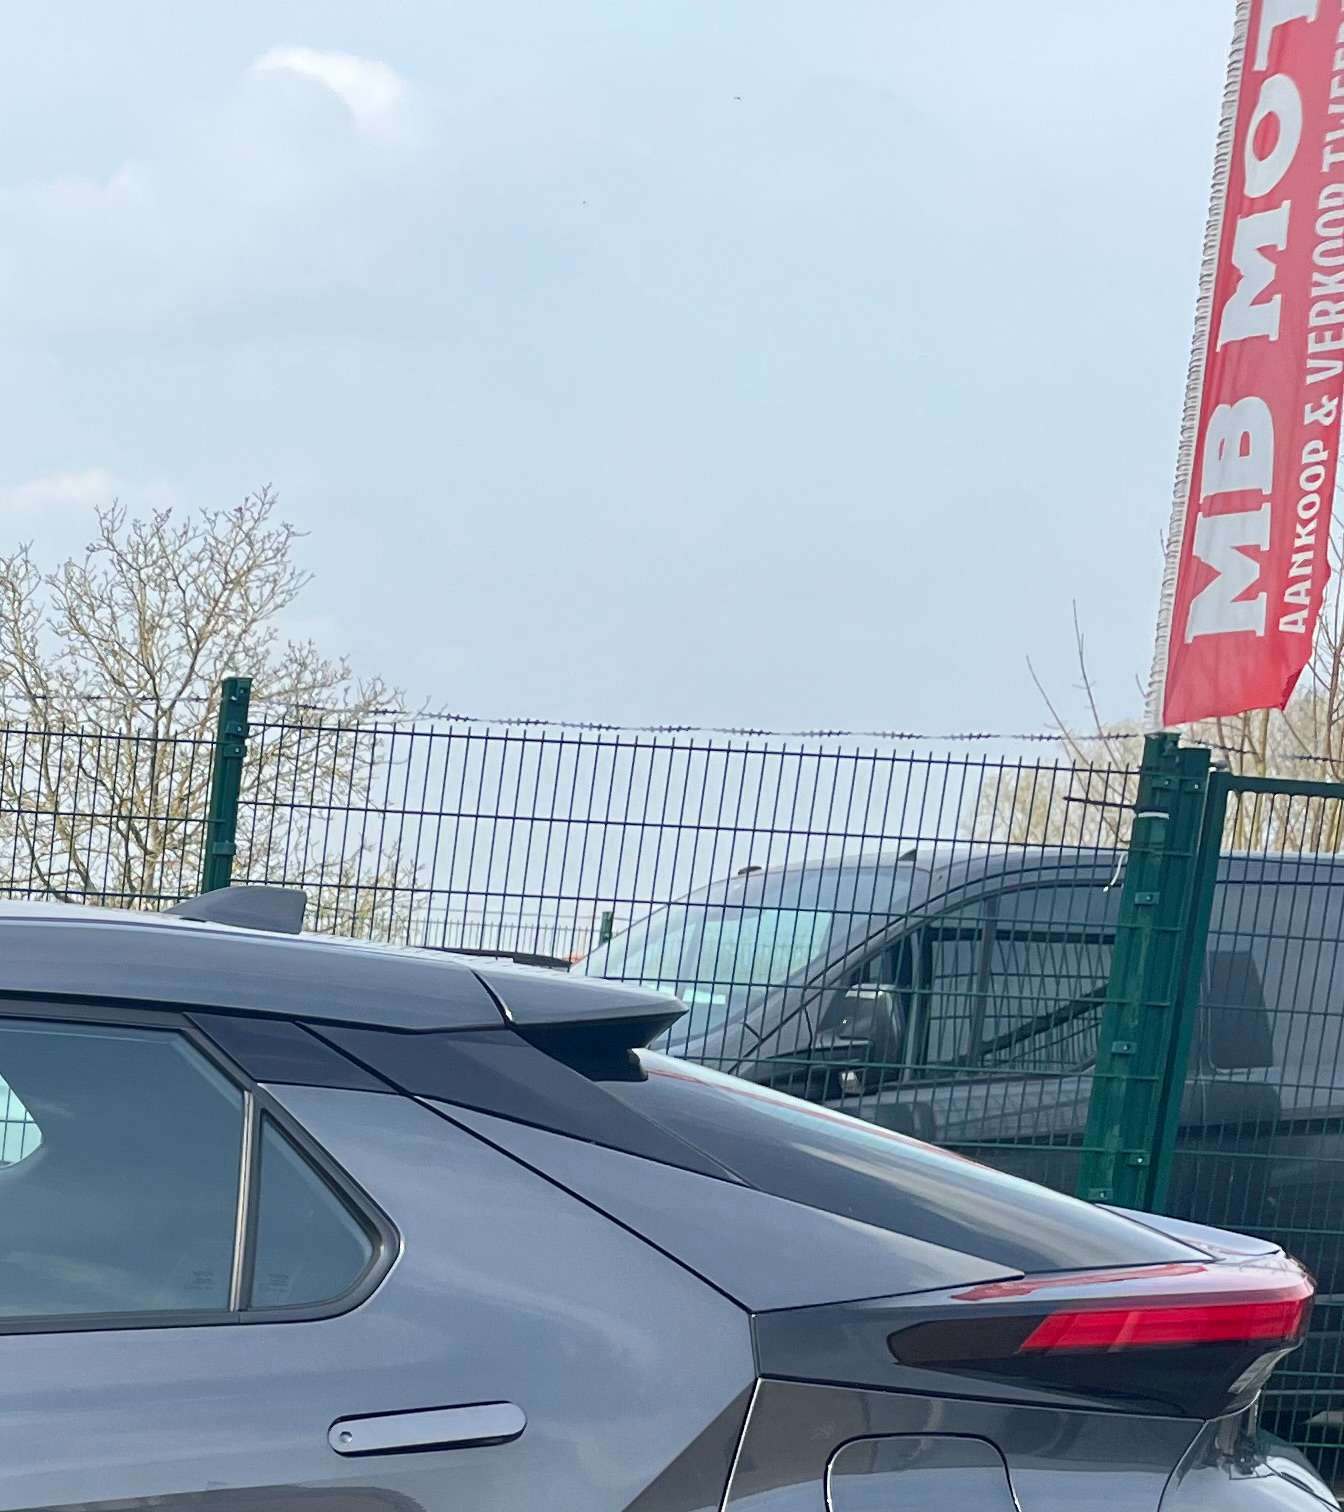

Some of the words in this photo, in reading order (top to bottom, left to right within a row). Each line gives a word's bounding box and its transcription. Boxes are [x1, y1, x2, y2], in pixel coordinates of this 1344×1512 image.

[1303, 394, 1339, 426] &
[1184, 395, 1275, 641] MB
[1278, 439, 1329, 634] AANKOOP
